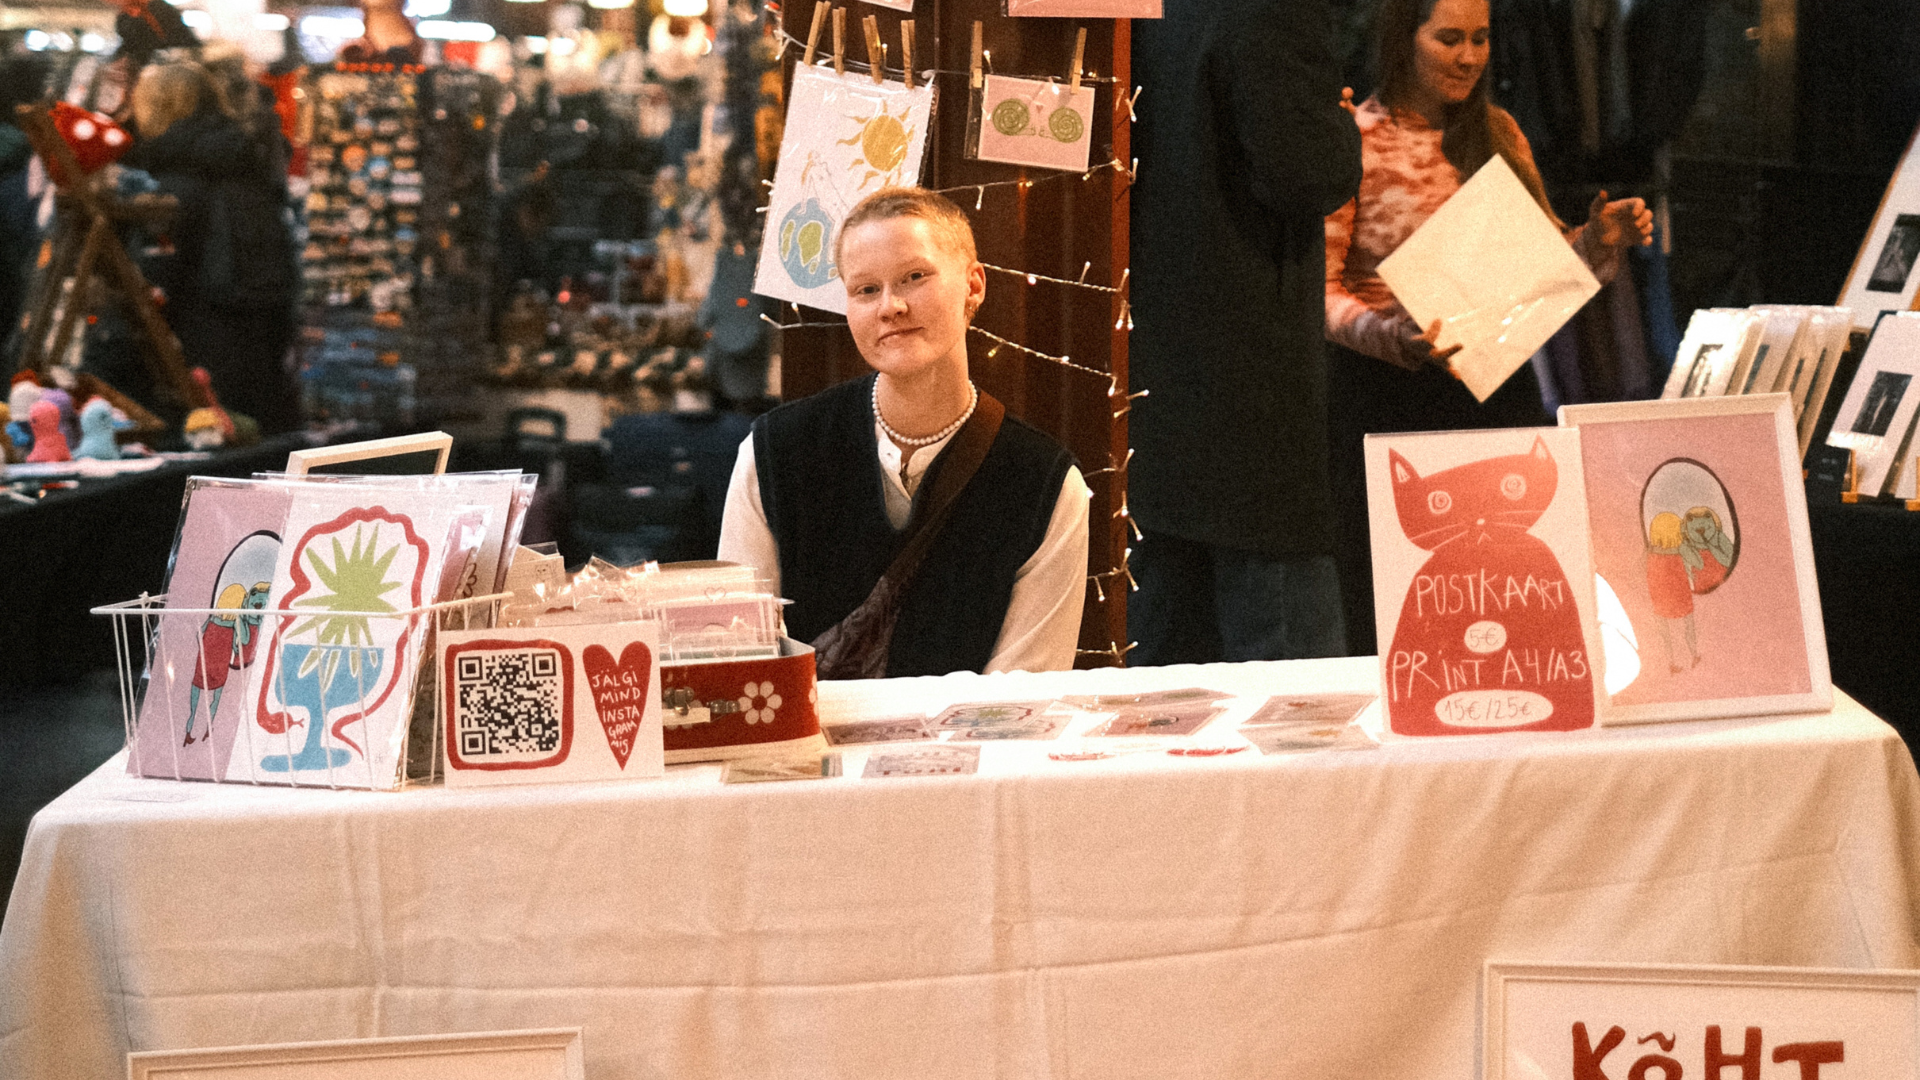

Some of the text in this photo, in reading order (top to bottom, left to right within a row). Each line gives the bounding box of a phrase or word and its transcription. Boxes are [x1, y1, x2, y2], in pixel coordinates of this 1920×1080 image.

[1416, 567, 1564, 617] POSTKAART
[1468, 627, 1500, 647] 5€
[608, 720, 637, 739] GRAM
